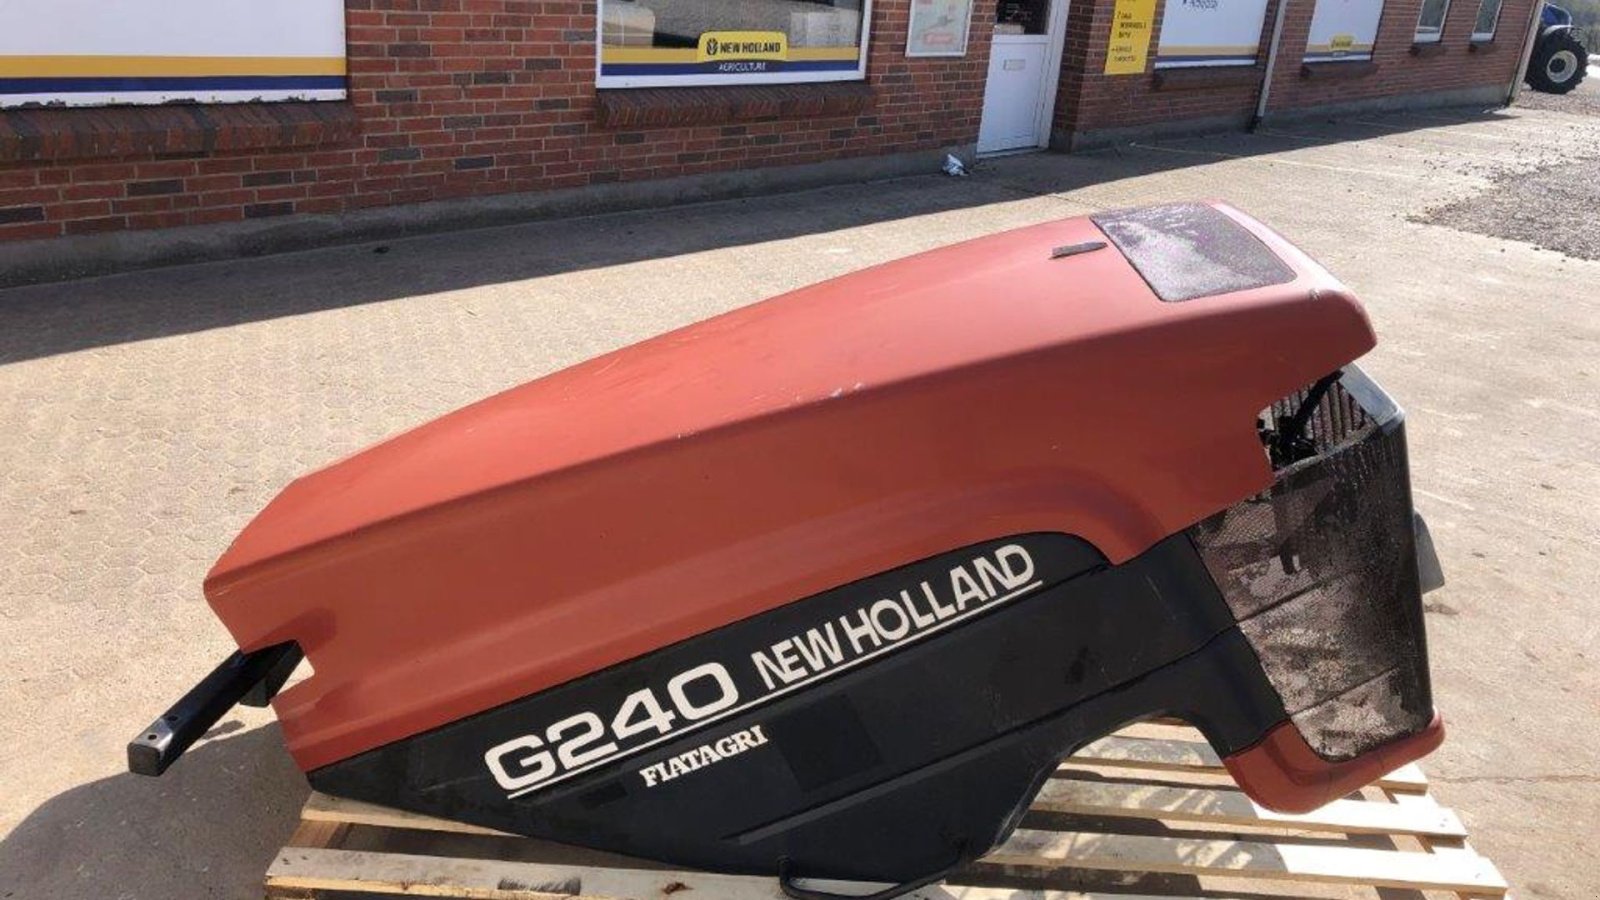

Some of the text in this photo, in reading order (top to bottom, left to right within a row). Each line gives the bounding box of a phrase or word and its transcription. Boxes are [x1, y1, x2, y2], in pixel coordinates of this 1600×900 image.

[720, 42, 780, 53] NEW HOLLAND
[485, 543, 1035, 790] G240 NEW HOLLAND
[640, 725, 769, 788] FIATAGRI
